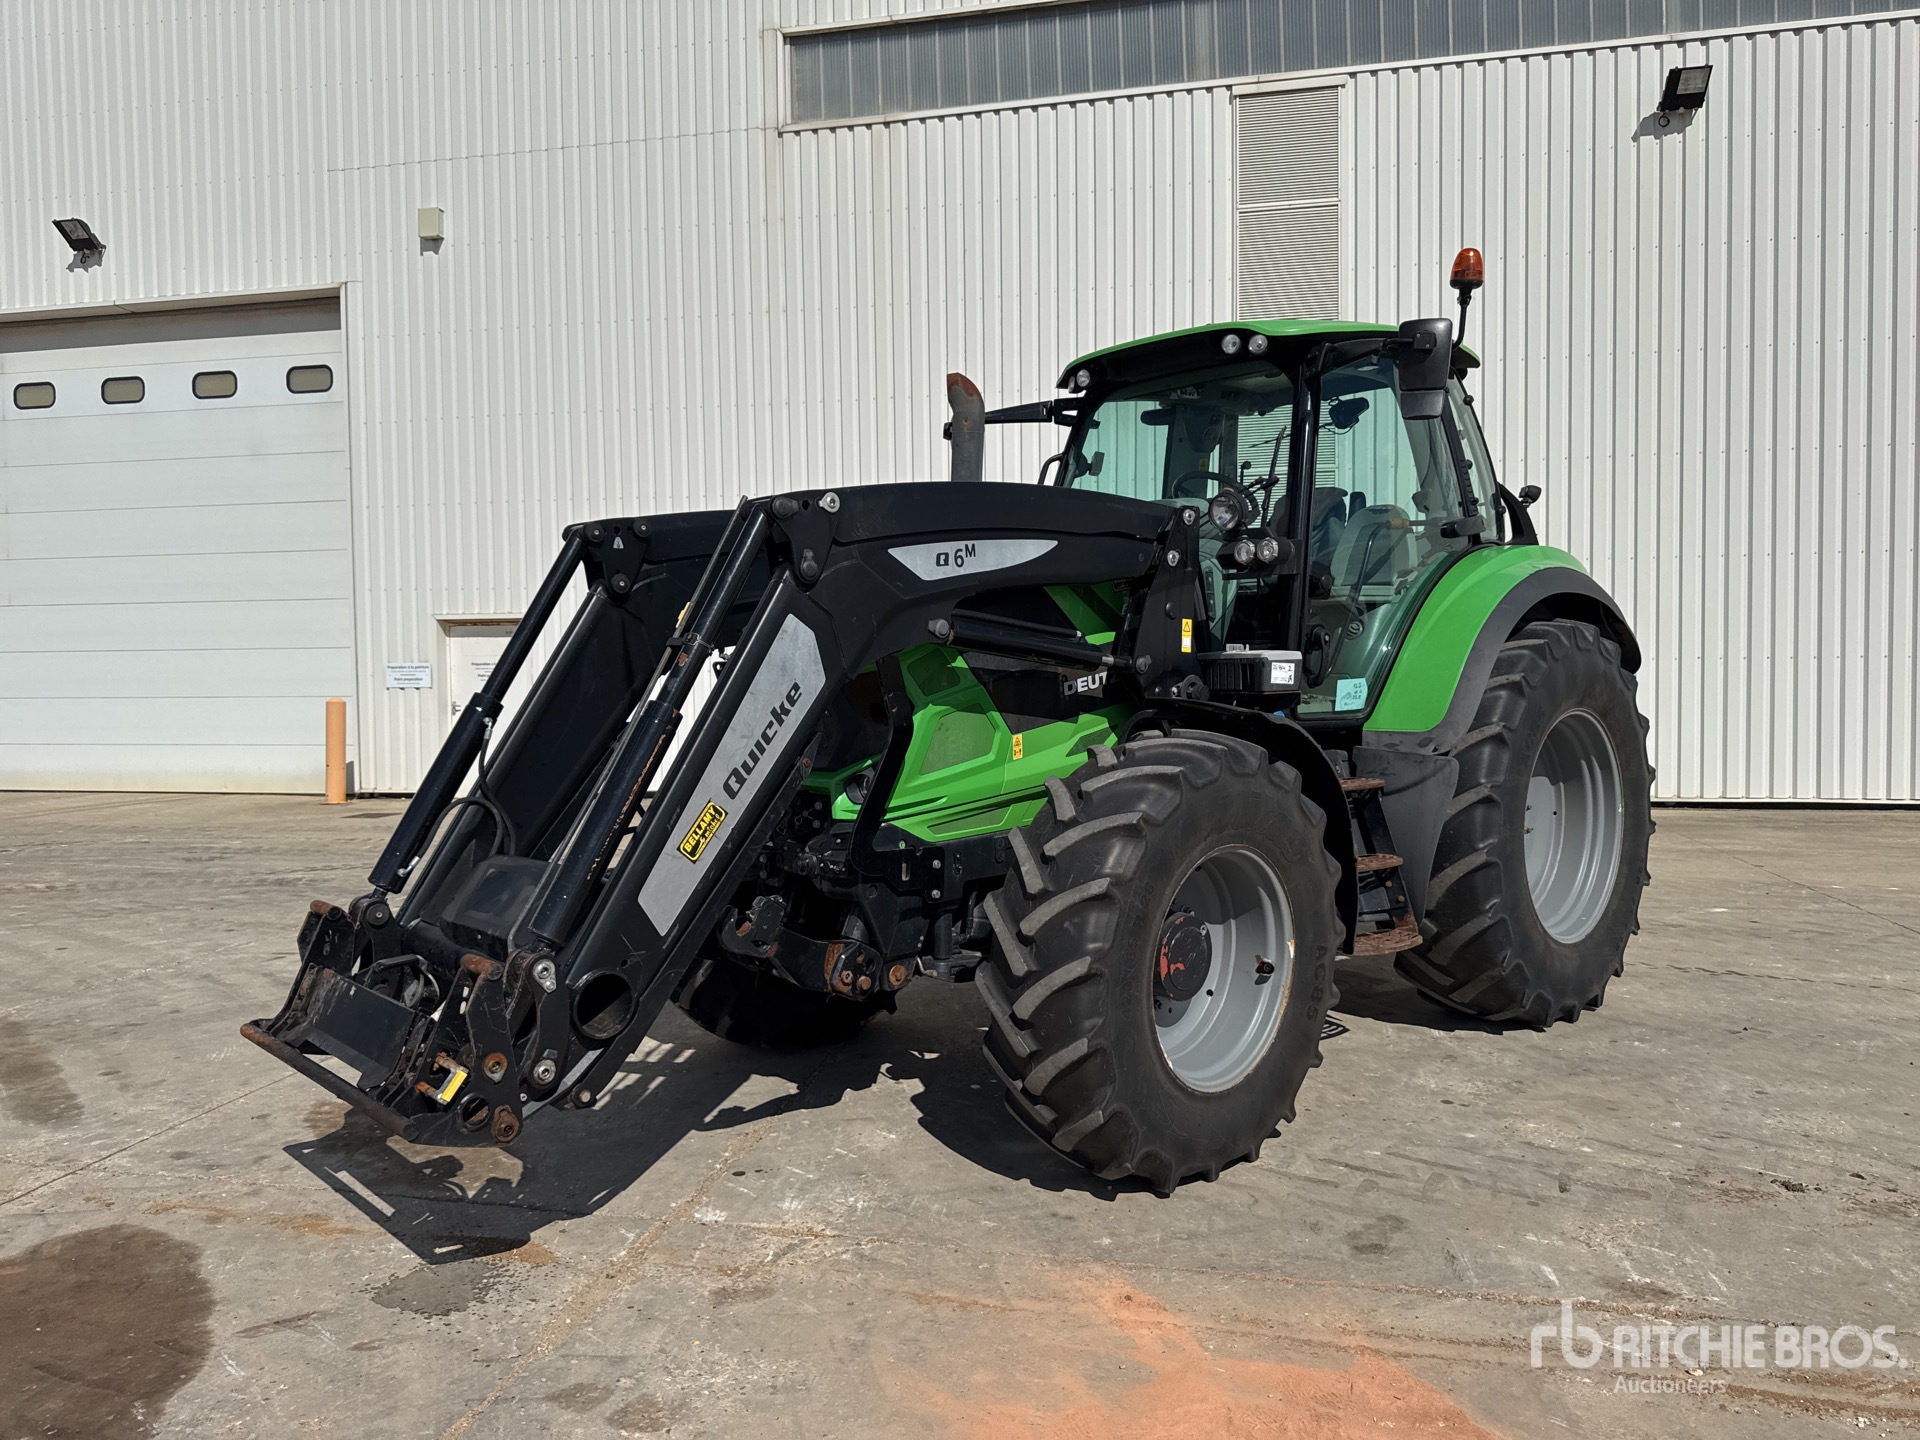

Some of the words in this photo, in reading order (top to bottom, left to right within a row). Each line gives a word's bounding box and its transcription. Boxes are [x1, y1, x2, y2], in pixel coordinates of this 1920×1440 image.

[722, 681, 803, 800] Quicke
[683, 805, 716, 853] BELLAMY
[1305, 944, 1329, 1022] AC85
